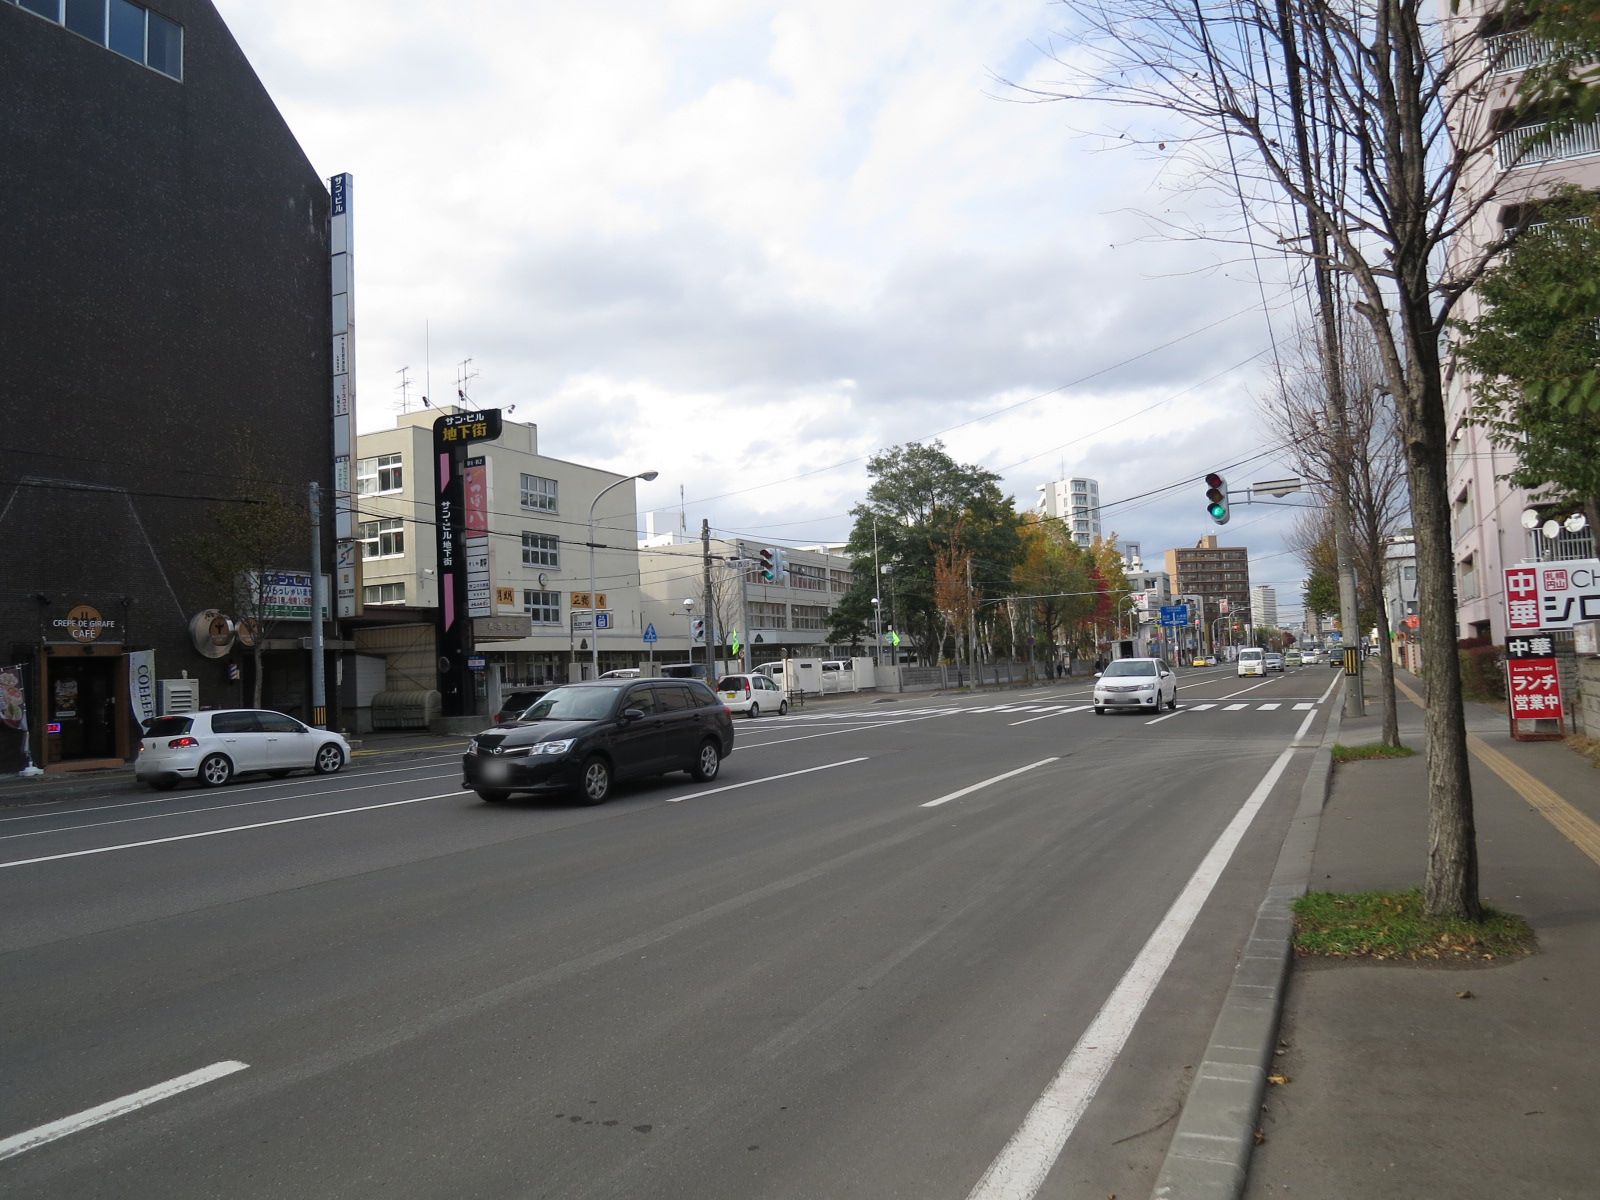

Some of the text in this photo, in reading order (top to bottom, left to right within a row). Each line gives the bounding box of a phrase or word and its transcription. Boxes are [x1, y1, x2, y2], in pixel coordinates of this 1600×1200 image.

[335, 176, 343, 213] サン・ビル
[445, 413, 485, 425] サン・ビル
[442, 422, 487, 441] 地下街
[441, 501, 453, 566] サン・ビル地下街
[1507, 571, 1538, 625] 中華
[53, 619, 77, 627] CREPE
[89, 620, 115, 628] GIRAFE
[1509, 637, 1552, 657] 中華
[138, 664, 154, 718] COFFEE
[1512, 674, 1556, 691] ランチ
[1514, 693, 1559, 711] 営業中
